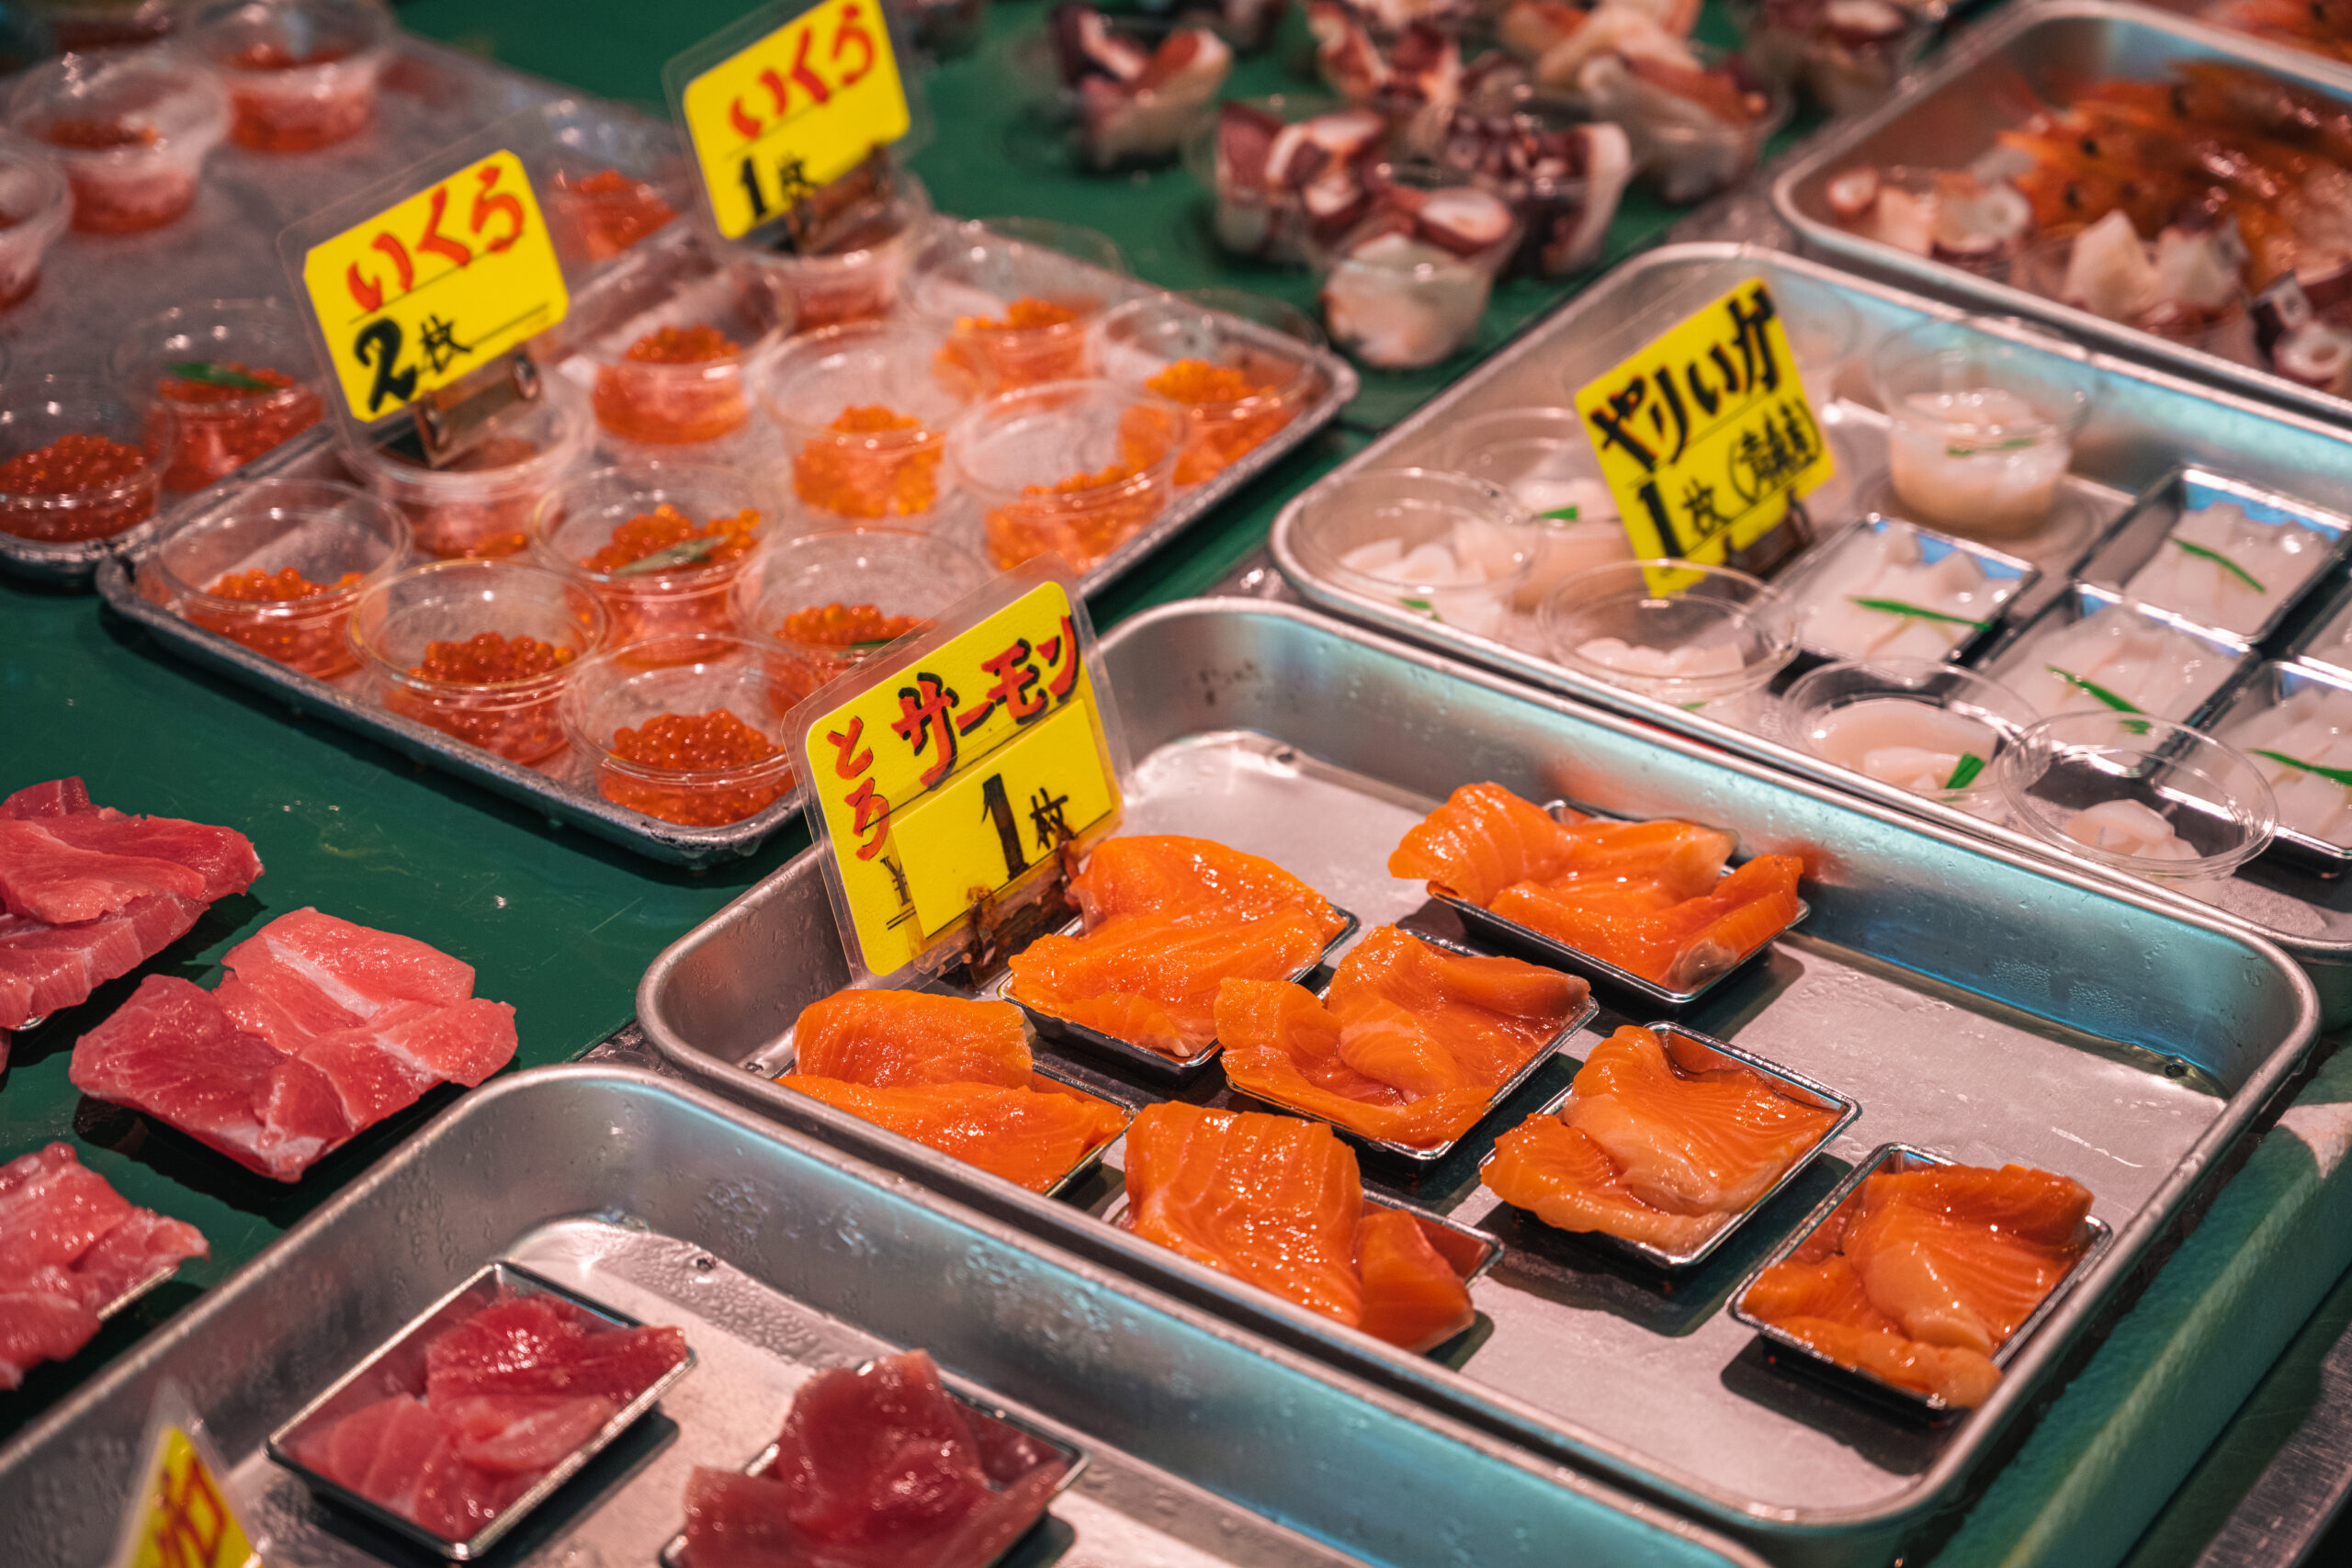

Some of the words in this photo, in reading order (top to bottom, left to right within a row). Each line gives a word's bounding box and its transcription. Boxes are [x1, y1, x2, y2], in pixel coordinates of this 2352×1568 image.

[729, 3, 876, 141] いくら
[346, 166, 525, 313] いくら
[354, 313, 472, 413] 2枚
[1638, 479, 1735, 558] 1枚
[891, 615, 1080, 792] サーモン
[827, 716, 890, 862] とろ
[981, 773, 1078, 882] 1枚
